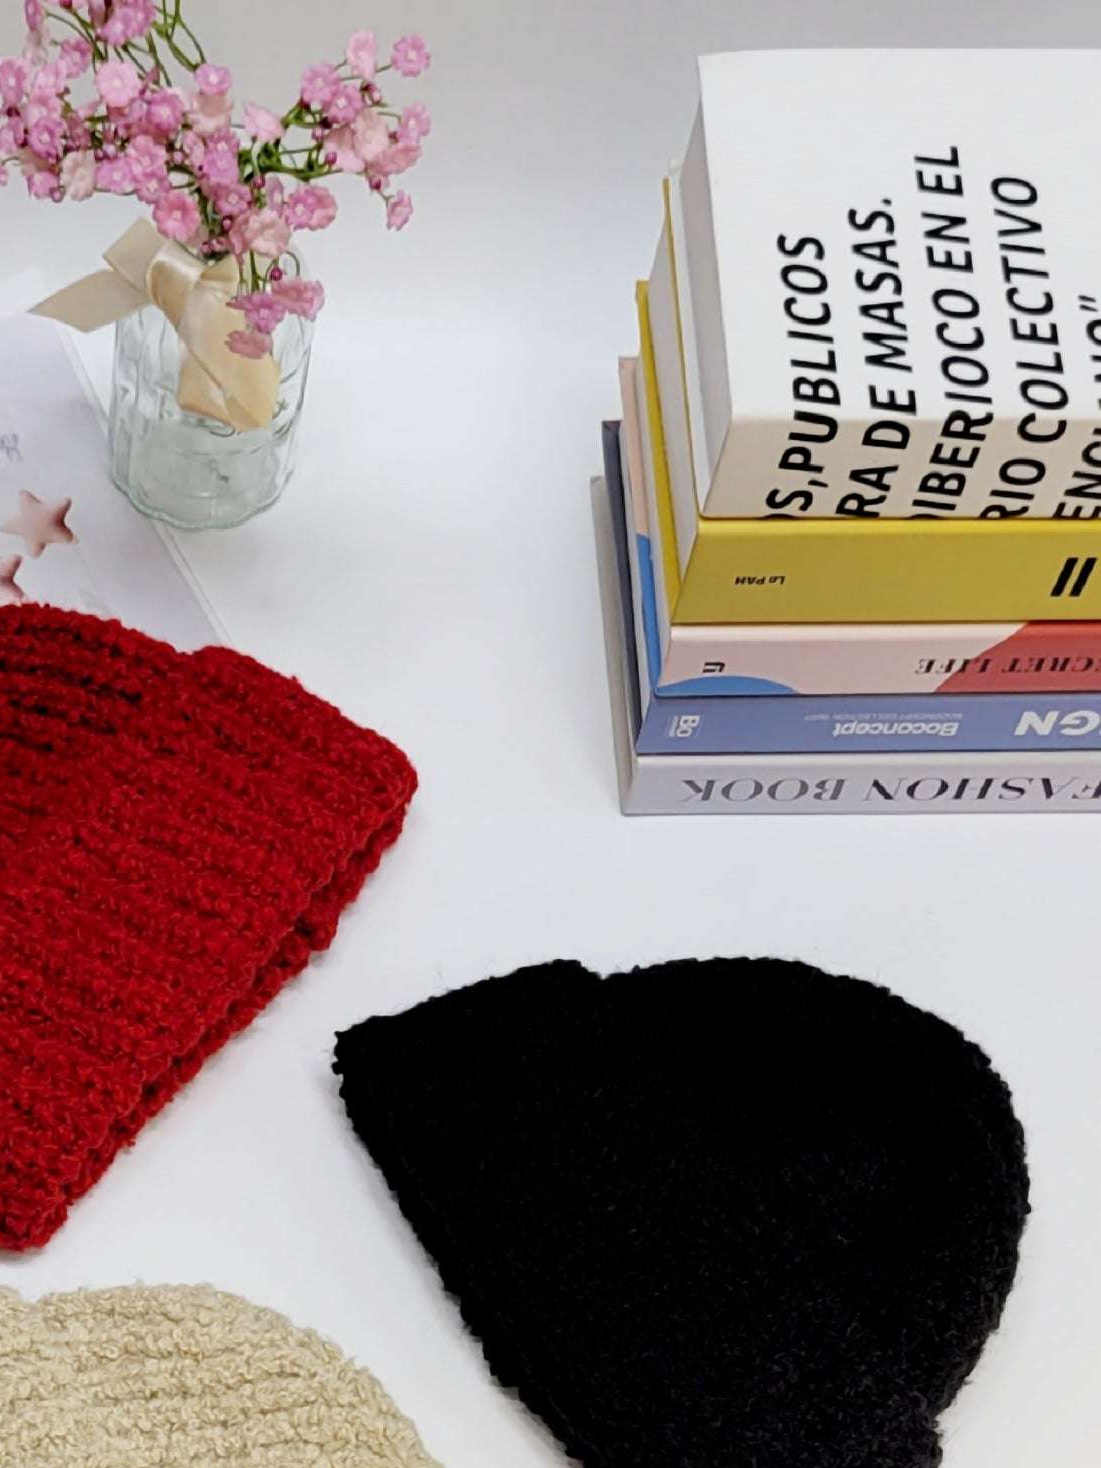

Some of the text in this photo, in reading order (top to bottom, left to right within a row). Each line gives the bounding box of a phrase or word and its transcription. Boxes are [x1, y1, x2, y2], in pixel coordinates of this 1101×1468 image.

[848, 198, 913, 373] MASAS.
[906, 146, 994, 518] IBERIOCO EN EL
[991, 177, 1069, 443] COLECTIVO
[762, 234, 841, 518] S,PUBLICOS
[862, 384, 917, 449] DE
[915, 656, 1101, 674] CRET LIFE
[833, 721, 960, 737] Boconcept
[682, 778, 846, 801] BOOK
